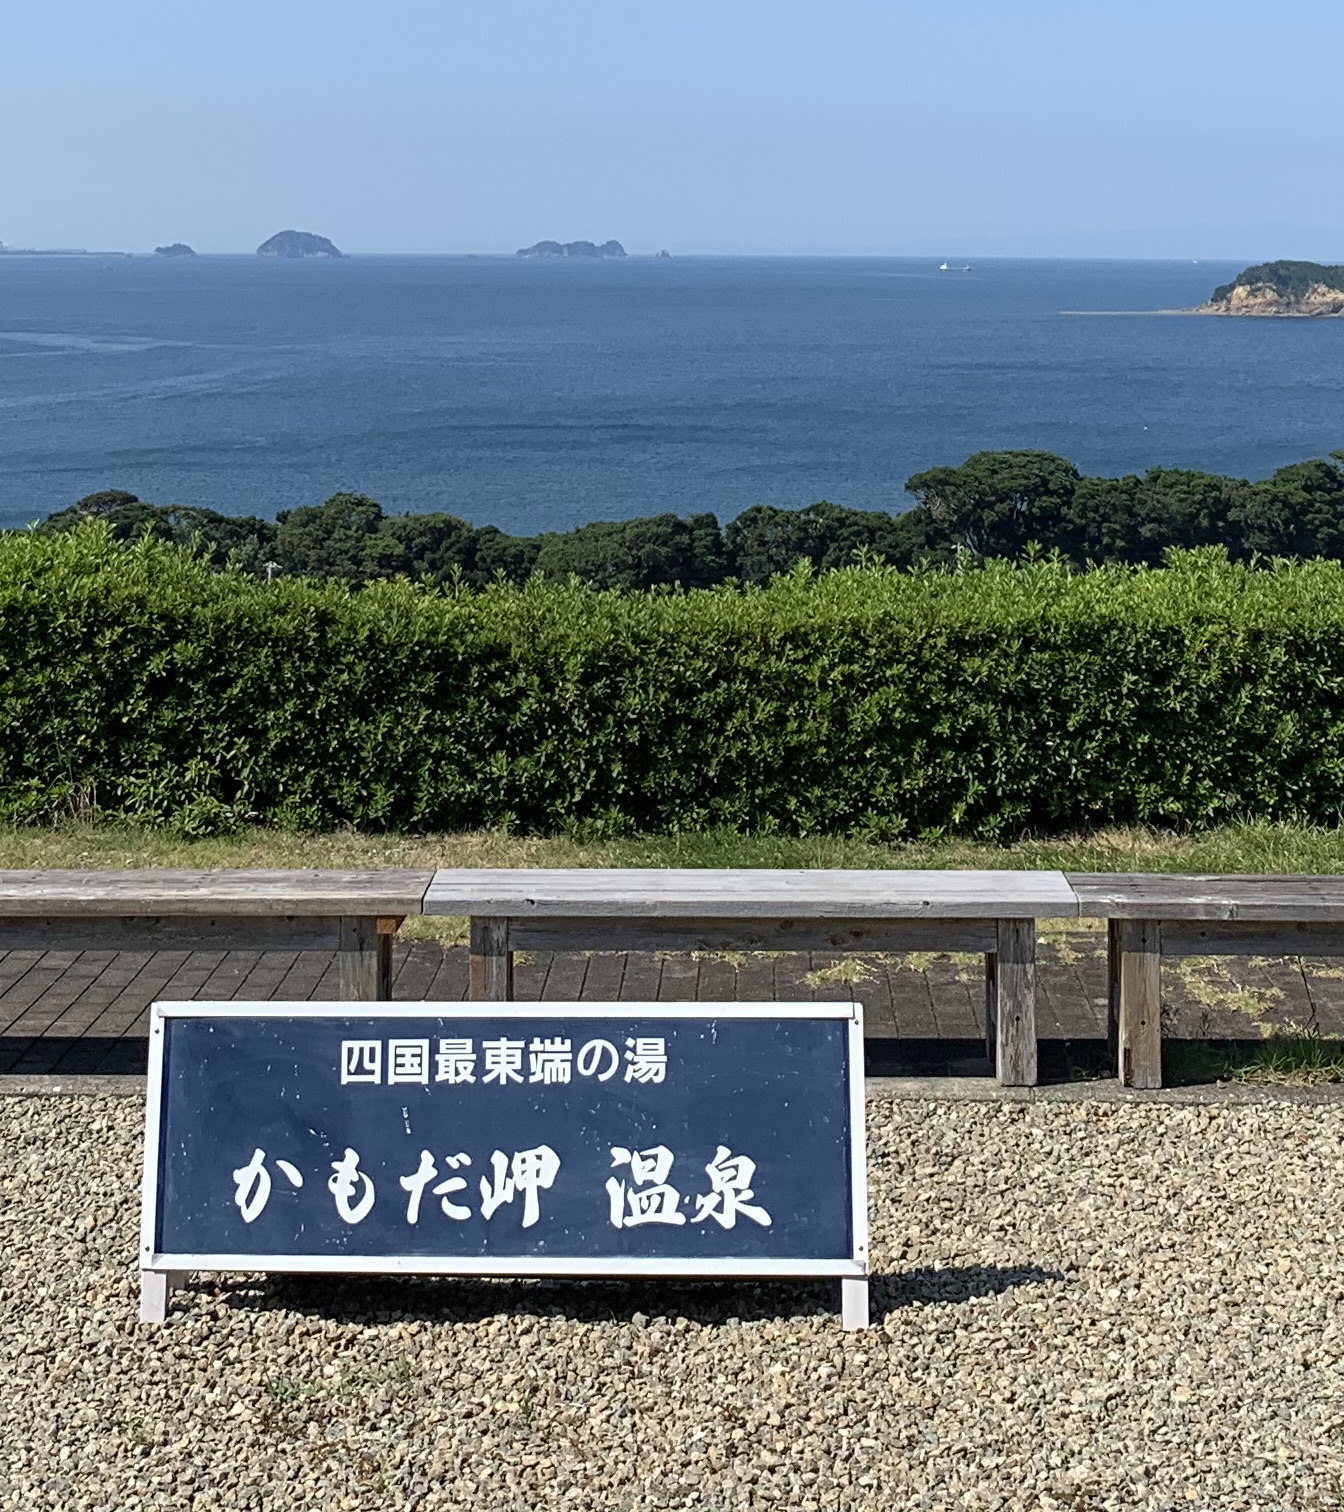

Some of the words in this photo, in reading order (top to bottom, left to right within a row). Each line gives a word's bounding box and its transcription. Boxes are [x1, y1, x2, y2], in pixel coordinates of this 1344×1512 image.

[340, 1037, 668, 1086] 四国最東端の湯
[233, 1145, 561, 1229] かもだ岬
[608, 1145, 772, 1229] 温泉
